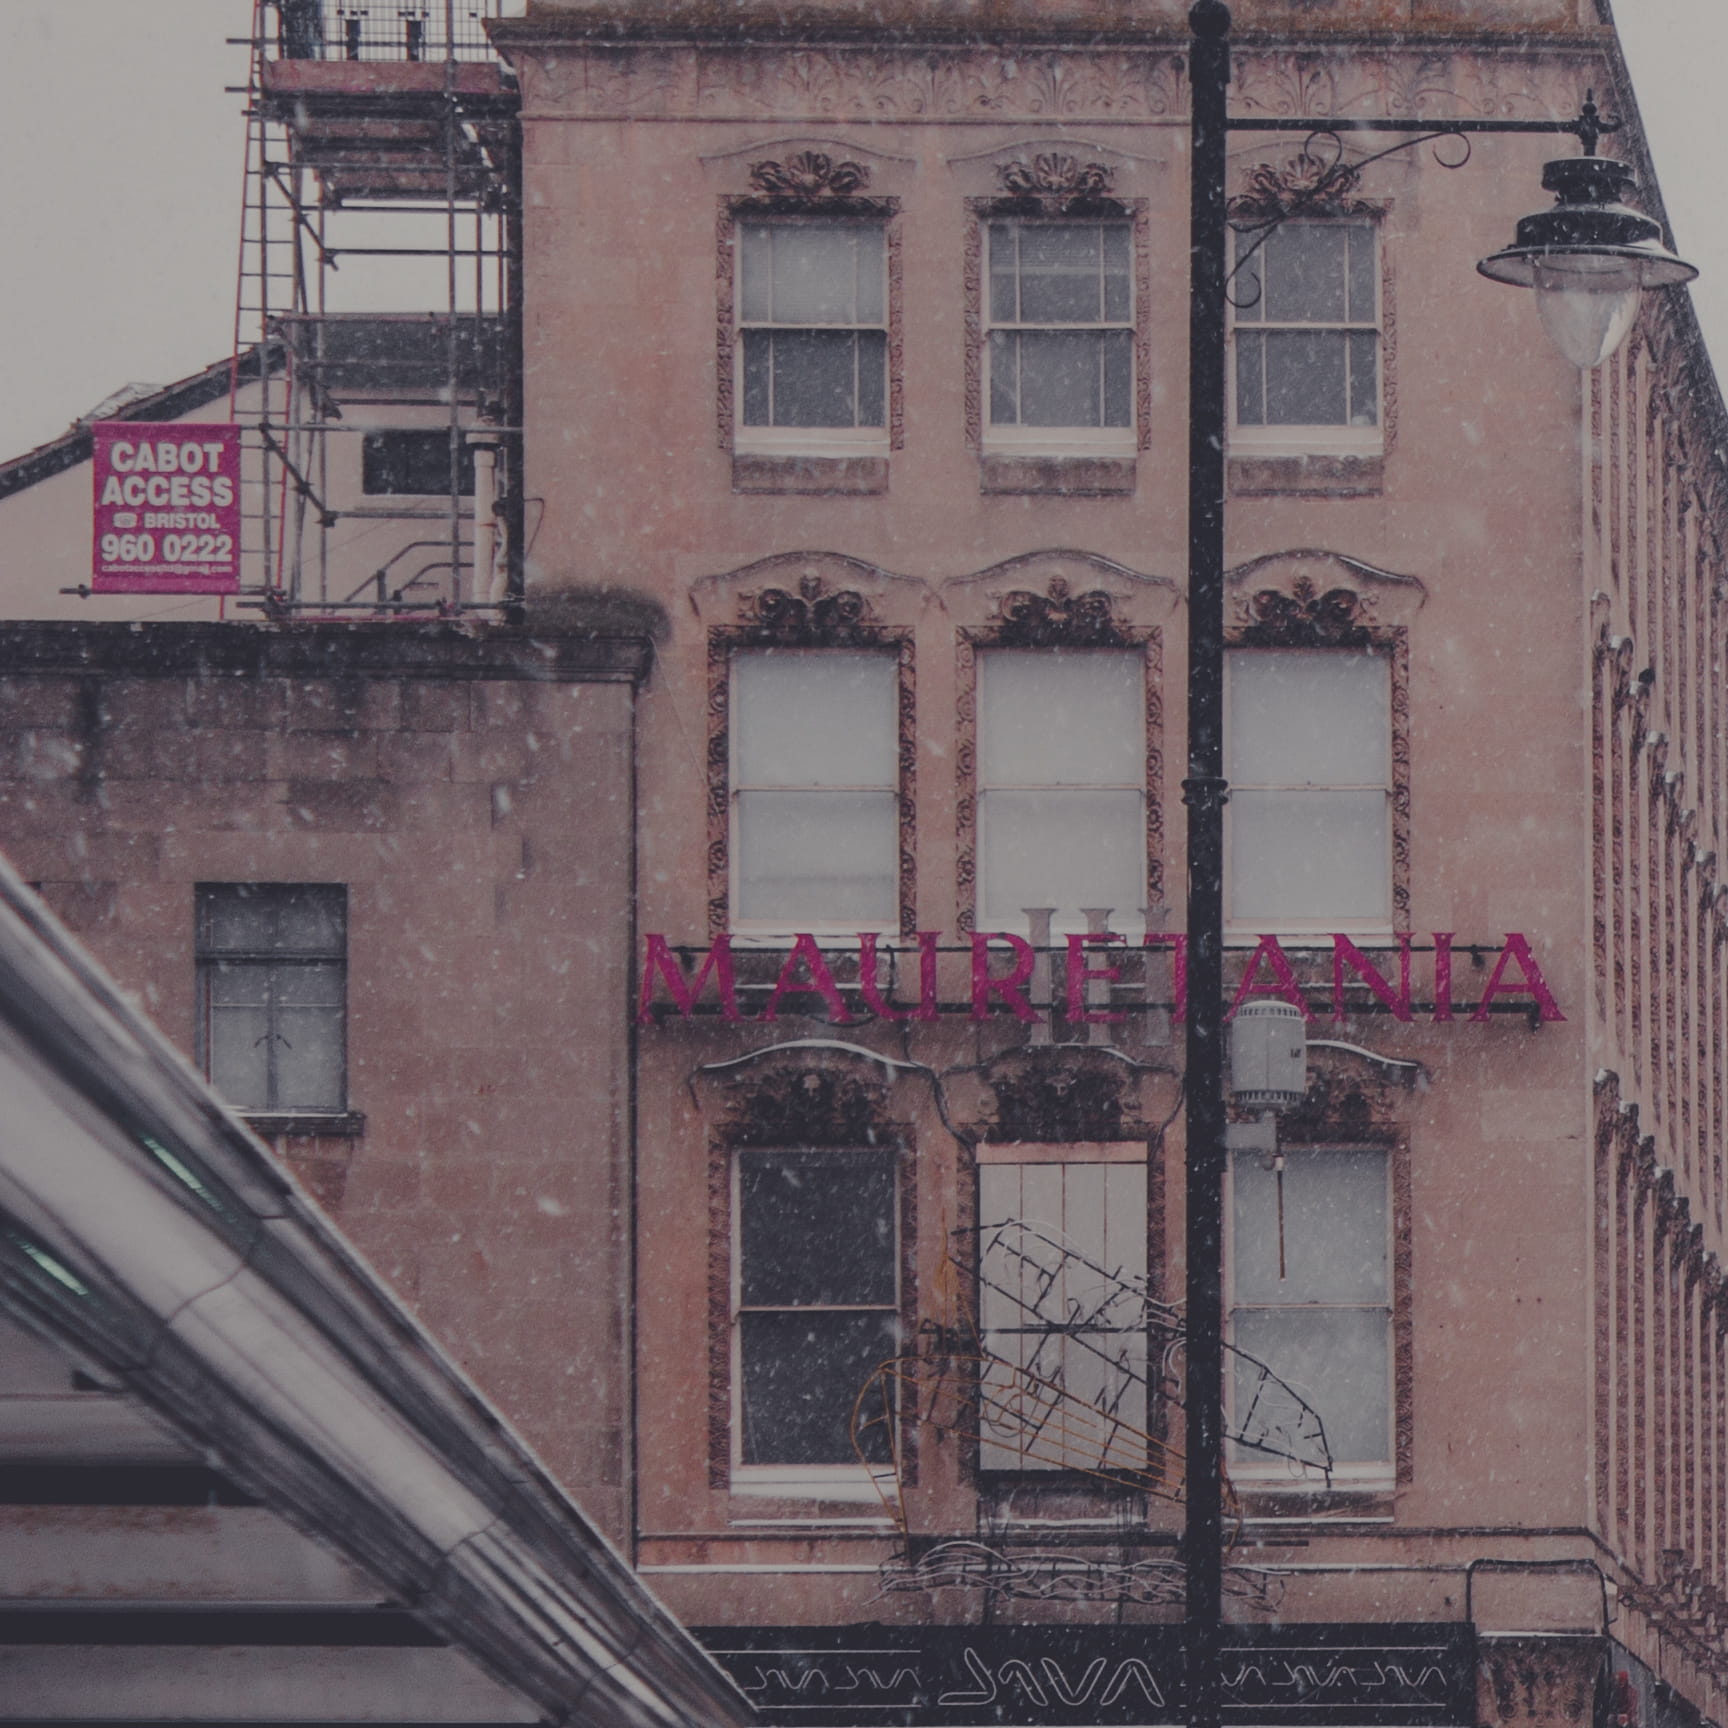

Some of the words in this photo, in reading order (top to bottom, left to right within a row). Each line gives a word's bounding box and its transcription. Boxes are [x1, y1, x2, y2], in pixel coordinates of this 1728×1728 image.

[110, 441, 224, 473] CABOT
[101, 475, 233, 507] ACCESS
[144, 512, 221, 529] BRISTOL
[102, 533, 155, 562] 960
[163, 533, 232, 562] 0222
[637, 932, 1569, 1025] MAURETANIA
[937, 1647, 1165, 1707] JAVA
